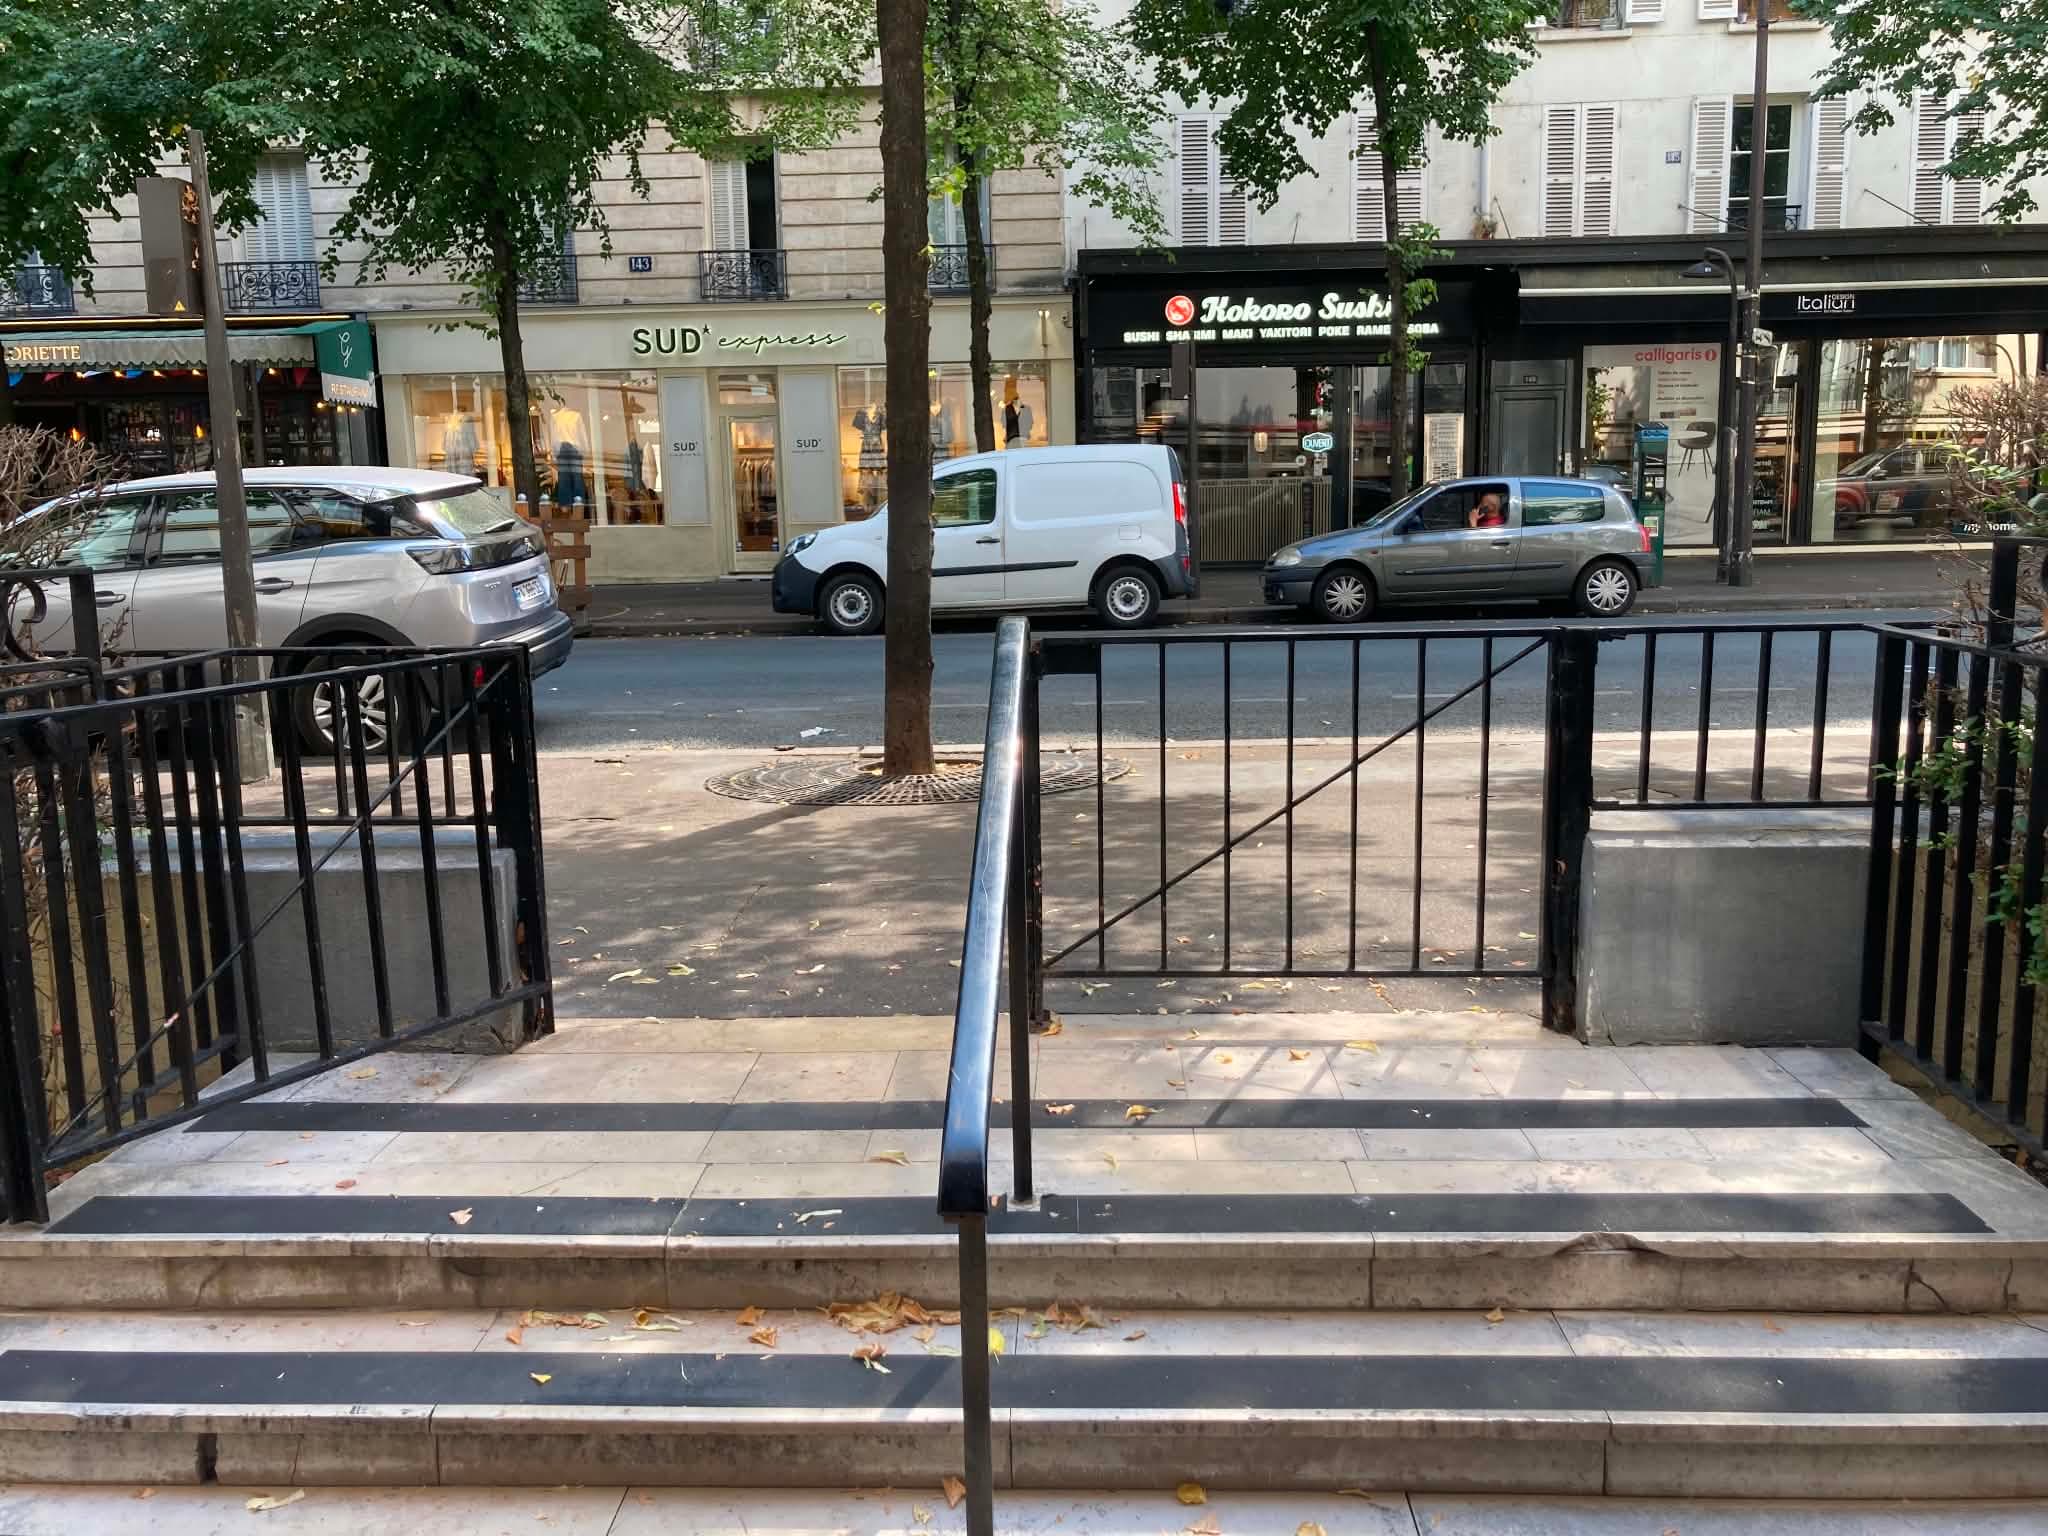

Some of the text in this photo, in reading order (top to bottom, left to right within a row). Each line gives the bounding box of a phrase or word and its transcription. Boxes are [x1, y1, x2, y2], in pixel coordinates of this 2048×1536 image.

[631, 257, 651, 271] 143
[1200, 296, 1311, 323] Kokoro
[1123, 331, 1160, 343] SUSHI
[1222, 328, 1253, 339] MAKI
[1259, 327, 1312, 338] YAKITORI
[1318, 325, 1350, 337] POKE
[1356, 324, 1392, 336] RAME
[1406, 323, 1439, 335] SOBA
[718, 333, 847, 354] express
[4, 344, 81, 361] ORIETTE
[1634, 347, 1702, 364] calligaris
[673, 442, 696, 452] SUD
[796, 439, 819, 448] SUD
